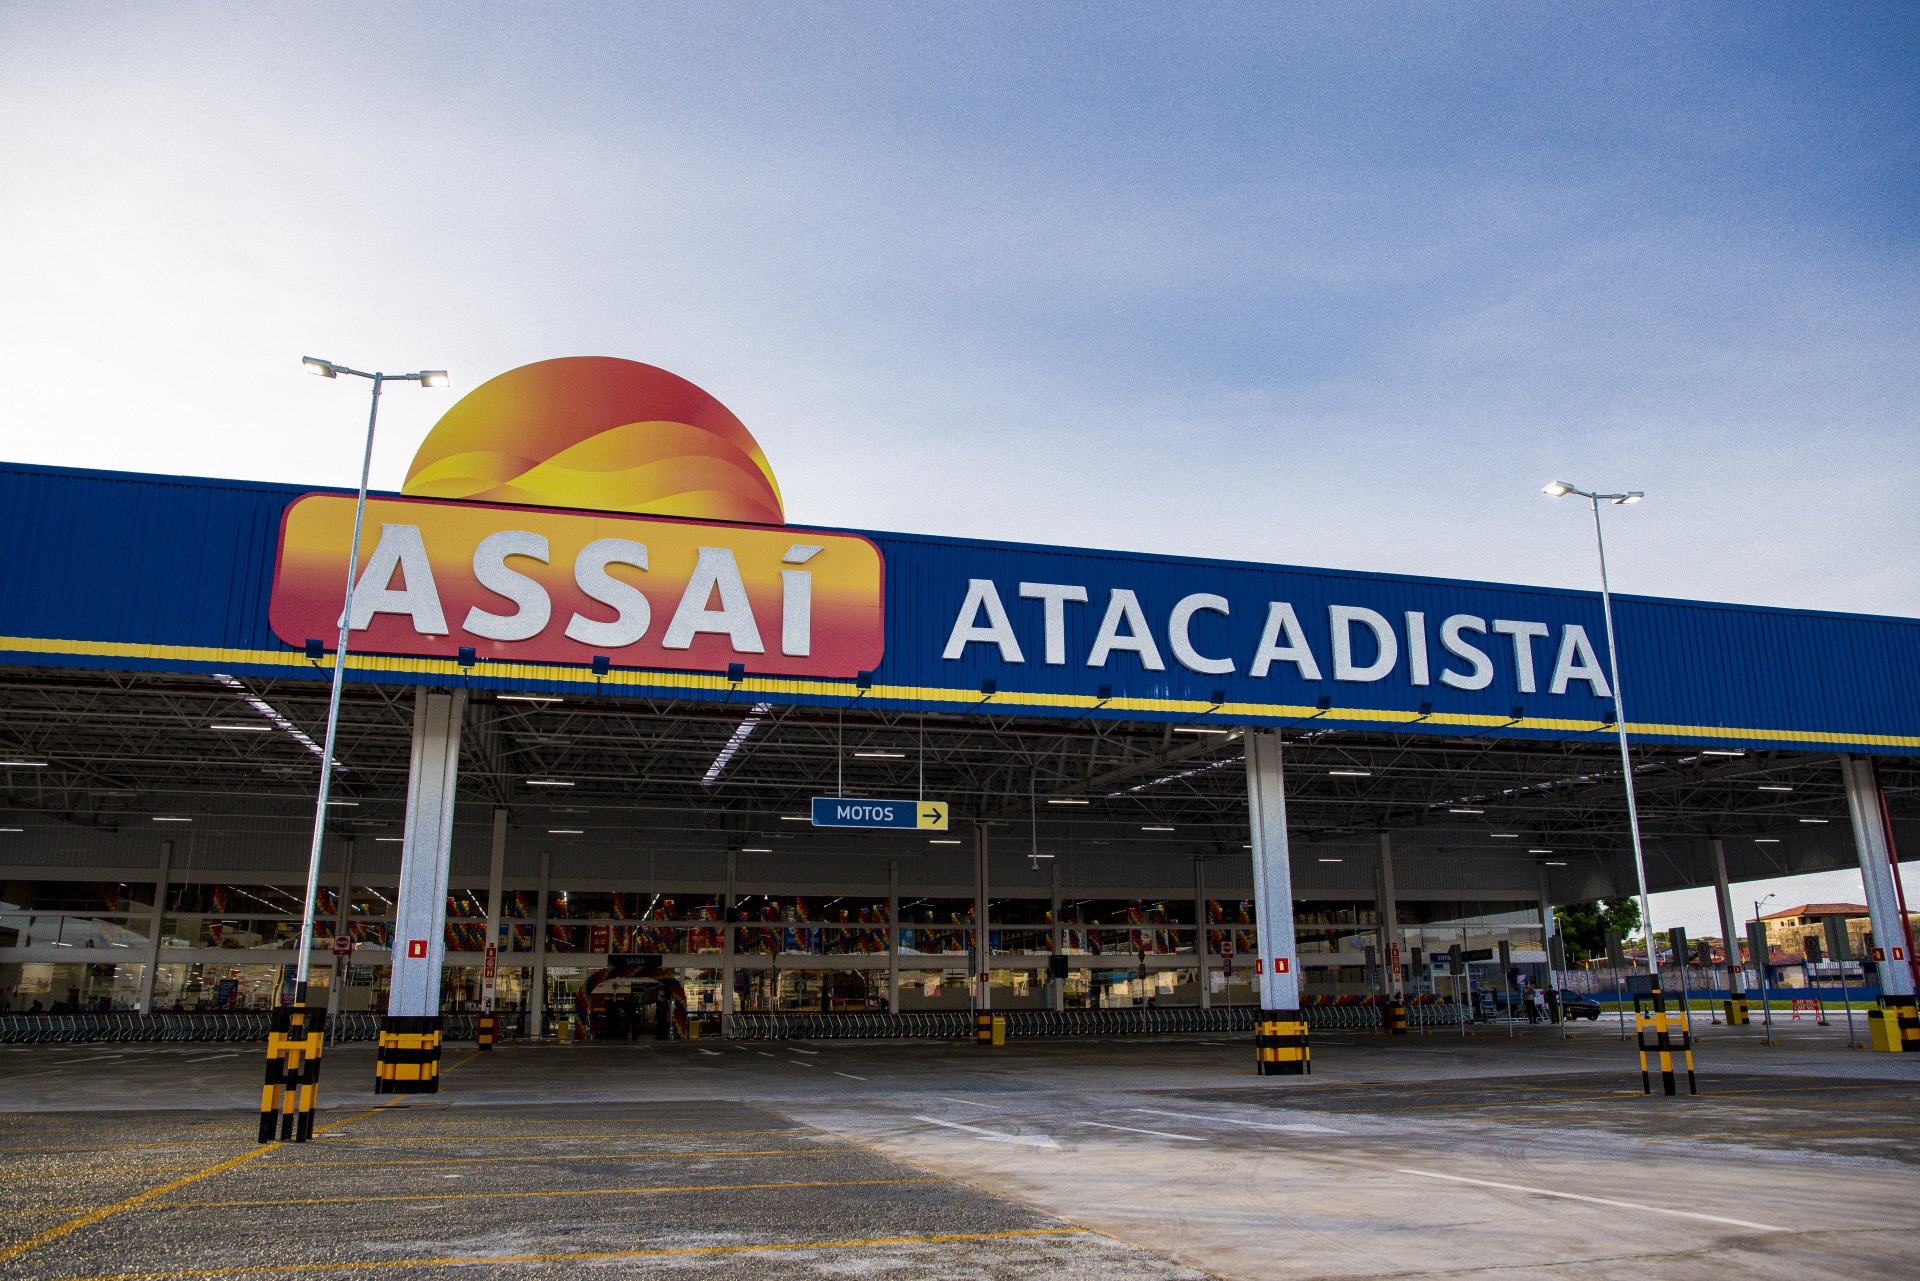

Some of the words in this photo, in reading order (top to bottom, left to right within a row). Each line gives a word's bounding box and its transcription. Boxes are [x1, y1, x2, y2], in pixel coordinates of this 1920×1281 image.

[337, 523, 825, 657] ASSAÍ
[942, 578, 1612, 698] ATACADISTA
[837, 805, 894, 821] MOTOS
[1808, 939, 1814, 947] E
[626, 956, 645, 964] SAÍDA
[486, 969, 493, 977] H
